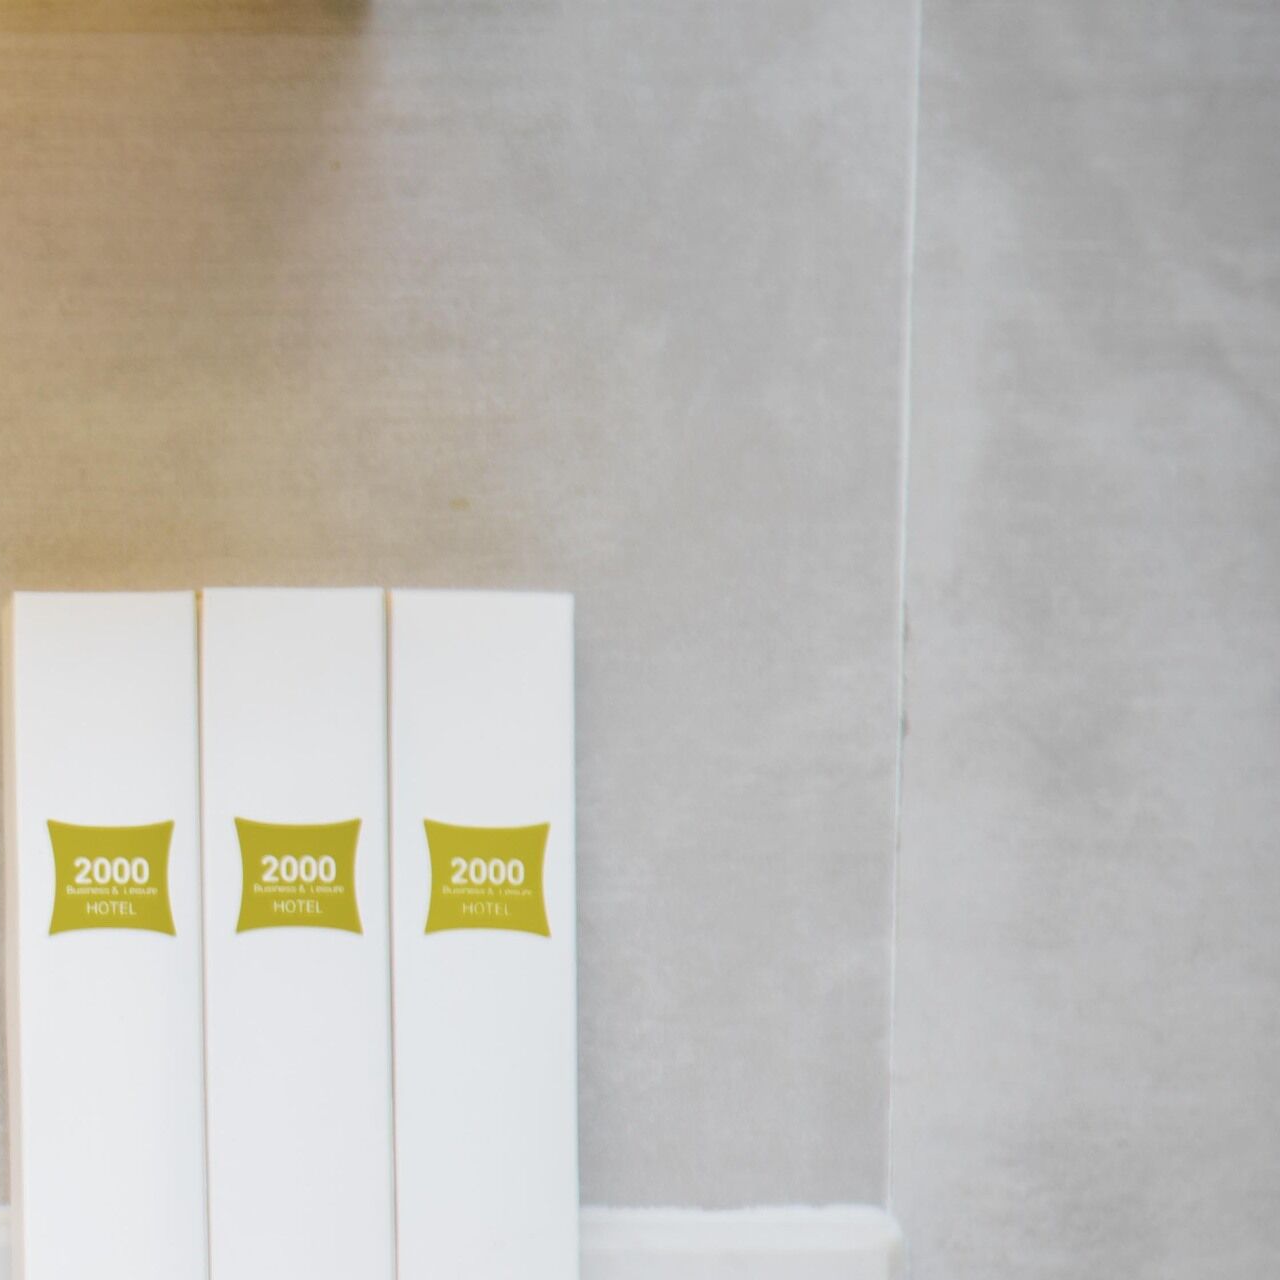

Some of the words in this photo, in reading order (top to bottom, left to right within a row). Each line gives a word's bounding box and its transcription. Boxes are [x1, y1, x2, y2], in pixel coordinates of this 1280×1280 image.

[73, 856, 149, 885] 2000
[260, 854, 336, 883] 2000
[450, 856, 525, 886] 2000
[85, 900, 137, 915] HOTEL
[272, 899, 323, 914] HOTEL
[462, 901, 512, 916] HOTEL
